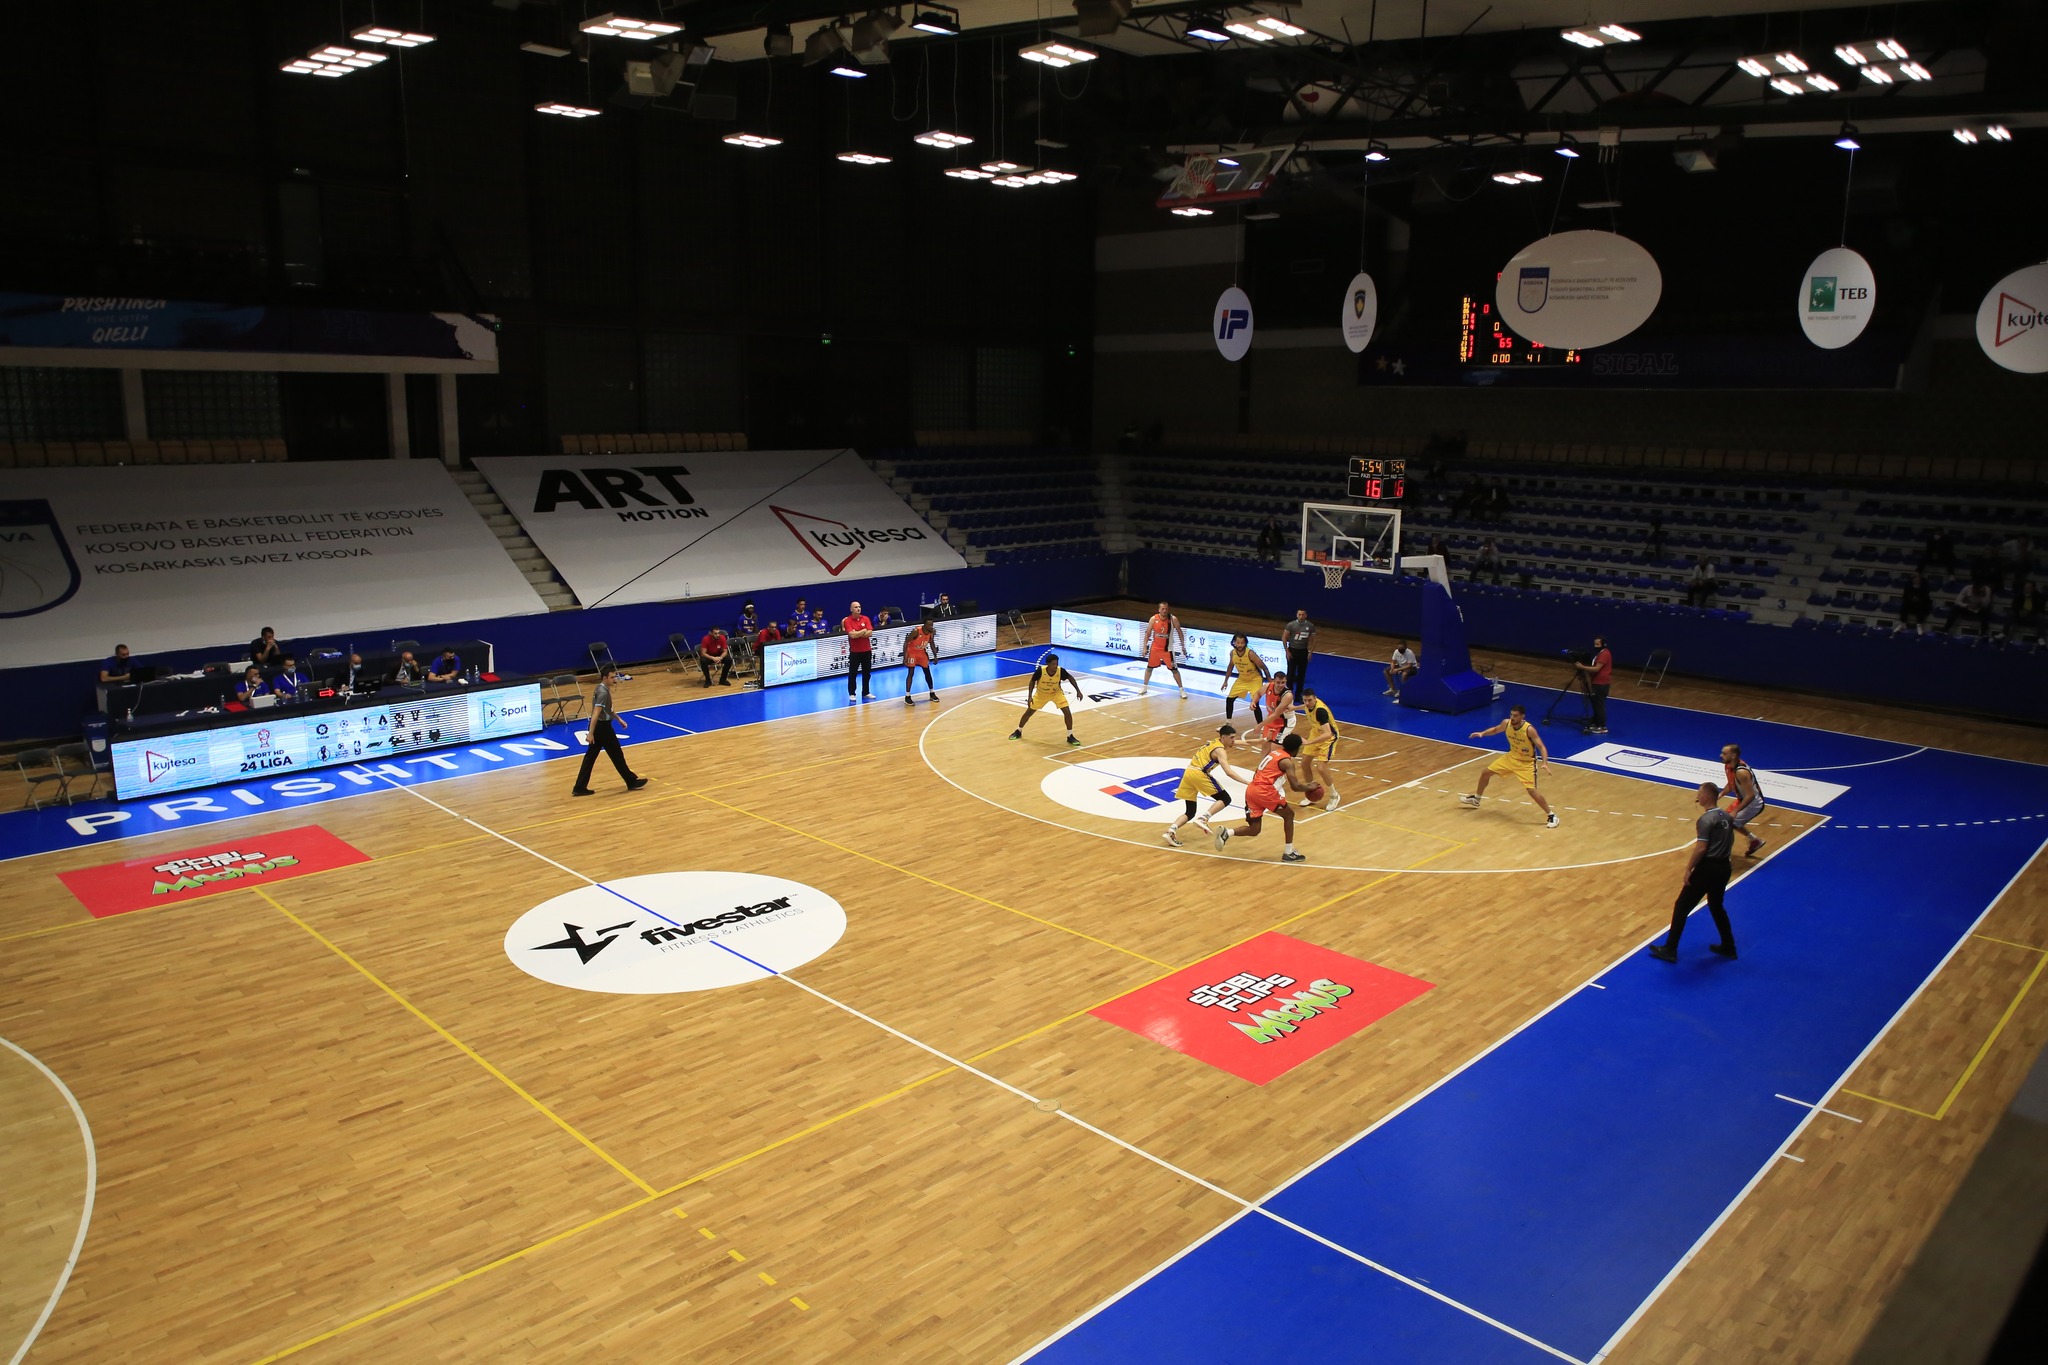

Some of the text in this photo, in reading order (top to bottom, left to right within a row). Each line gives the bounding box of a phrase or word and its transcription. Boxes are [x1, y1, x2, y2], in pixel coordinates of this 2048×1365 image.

[1839, 287, 1868, 300] TEB
[1219, 309, 1249, 340] IP
[91, 326, 149, 343] QIELLI
[1499, 338, 1512, 349] 65
[1592, 353, 1679, 375] SIGAL
[1359, 460, 1382, 473] 7:54
[533, 466, 695, 513] ART
[1365, 480, 1404, 499] 16 16
[76, 506, 445, 536] FEDERATA E BASKETBOLLIT TË KOSOVËS
[617, 507, 709, 523] MOTION
[85, 525, 415, 555] KOSOVO BASKETBALL FEDERATION
[808, 522, 928, 551] kujtesa
[94, 547, 374, 575] KOSARKASKI SAVEZ KOSOVA
[1790, 577, 1798, 586] 4
[1778, 598, 1786, 609] 3
[1105, 641, 1132, 652] 24 LIGA
[783, 657, 807, 668] kujtesa
[1260, 654, 1279, 663] Sport
[1087, 688, 1139, 703] ART
[501, 704, 528, 717] Sport
[246, 748, 285, 760] SPORT HD
[153, 756, 196, 771] kujtesa
[240, 755, 294, 773] 24 LIGA
[152, 855, 300, 895] MAGNUS
[660, 907, 804, 954] FITNESS & ATHLETICS
[1187, 971, 1266, 1008] STOBI
[1215, 973, 1297, 1013] FLIPS
[1227, 978, 1355, 1045] MAGNUS
